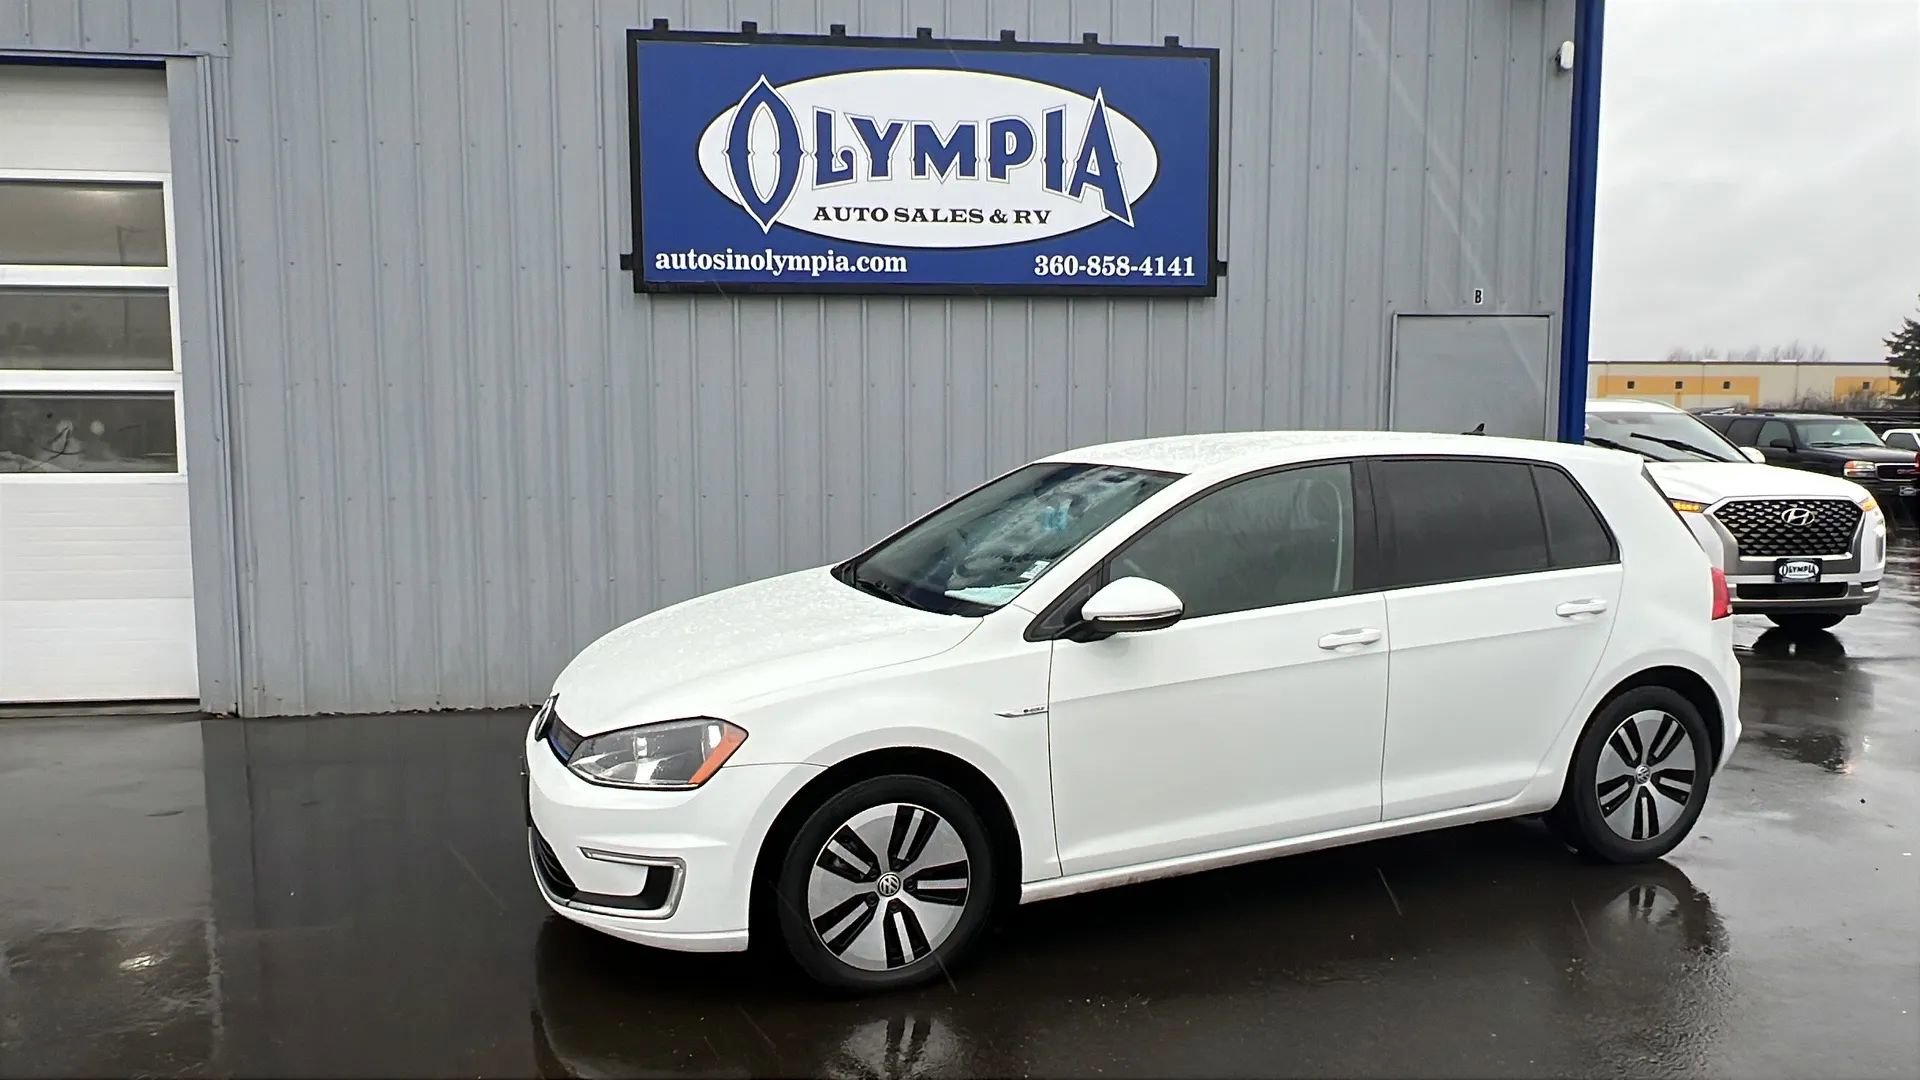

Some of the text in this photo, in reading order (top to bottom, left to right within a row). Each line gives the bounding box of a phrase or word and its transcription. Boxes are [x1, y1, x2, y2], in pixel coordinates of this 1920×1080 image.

[725, 74, 1135, 234] OLYMPIA
[814, 206, 1051, 225] AUTO SALES & RV
[655, 248, 907, 276] autosinolympia.com
[1034, 255, 1195, 278] 360-858-4141
[1475, 289, 1482, 304] B
